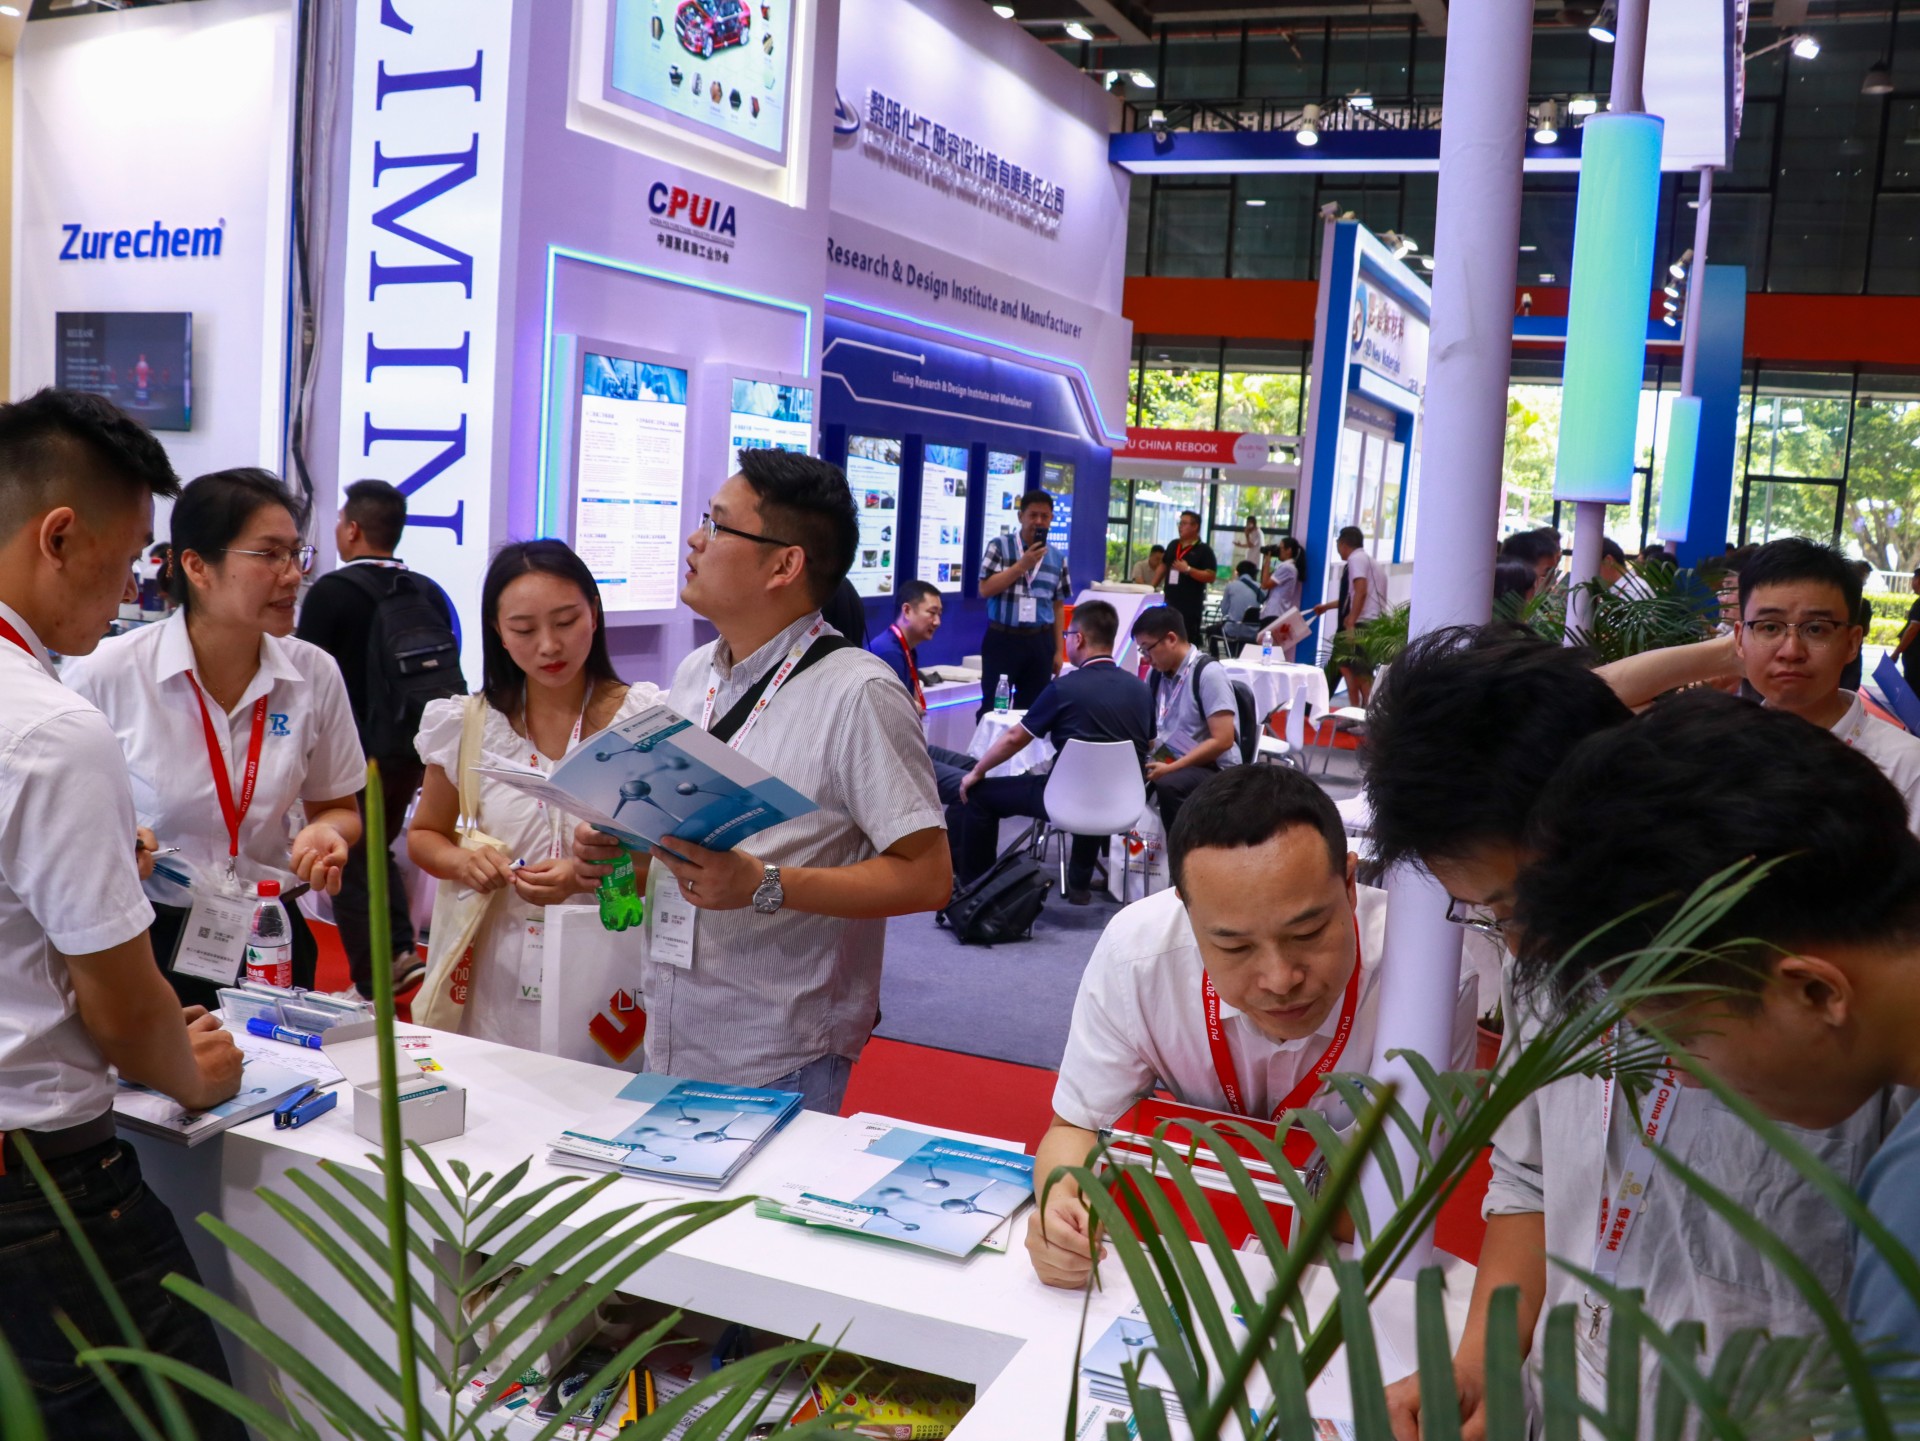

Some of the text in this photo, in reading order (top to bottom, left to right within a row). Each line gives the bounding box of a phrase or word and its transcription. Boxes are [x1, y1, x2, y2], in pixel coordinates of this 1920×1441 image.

[868, 88, 1065, 215] 黎明化工研究设计院有限责任公司
[648, 181, 736, 238] CPUIA
[59, 220, 223, 261] Zurechem
[827, 237, 1082, 340] Research & Design Institute and Manufacturer
[361, 0, 484, 656] IMIN
[893, 370, 914, 388] Liming
[915, 375, 941, 391] Research
[948, 382, 967, 398] Design
[968, 386, 989, 400] Institute
[990, 391, 1000, 402] and
[1000, 392, 1032, 409] Manufacturer
[1139, 439, 1172, 451] CHINA
[1175, 441, 1218, 454] REBOOK
[247, 761, 256, 779] 2023
[244, 779, 253, 801] China
[1208, 1000, 1217, 1026] China
[1341, 1016, 1351, 1030] PU
[1212, 1028, 1220, 1041] PU
[1328, 1032, 1346, 1059] China
[1225, 1083, 1237, 1102] 2023
[1651, 1088, 1670, 1121] China
[1606, 1208, 1632, 1252] 恒光新材
